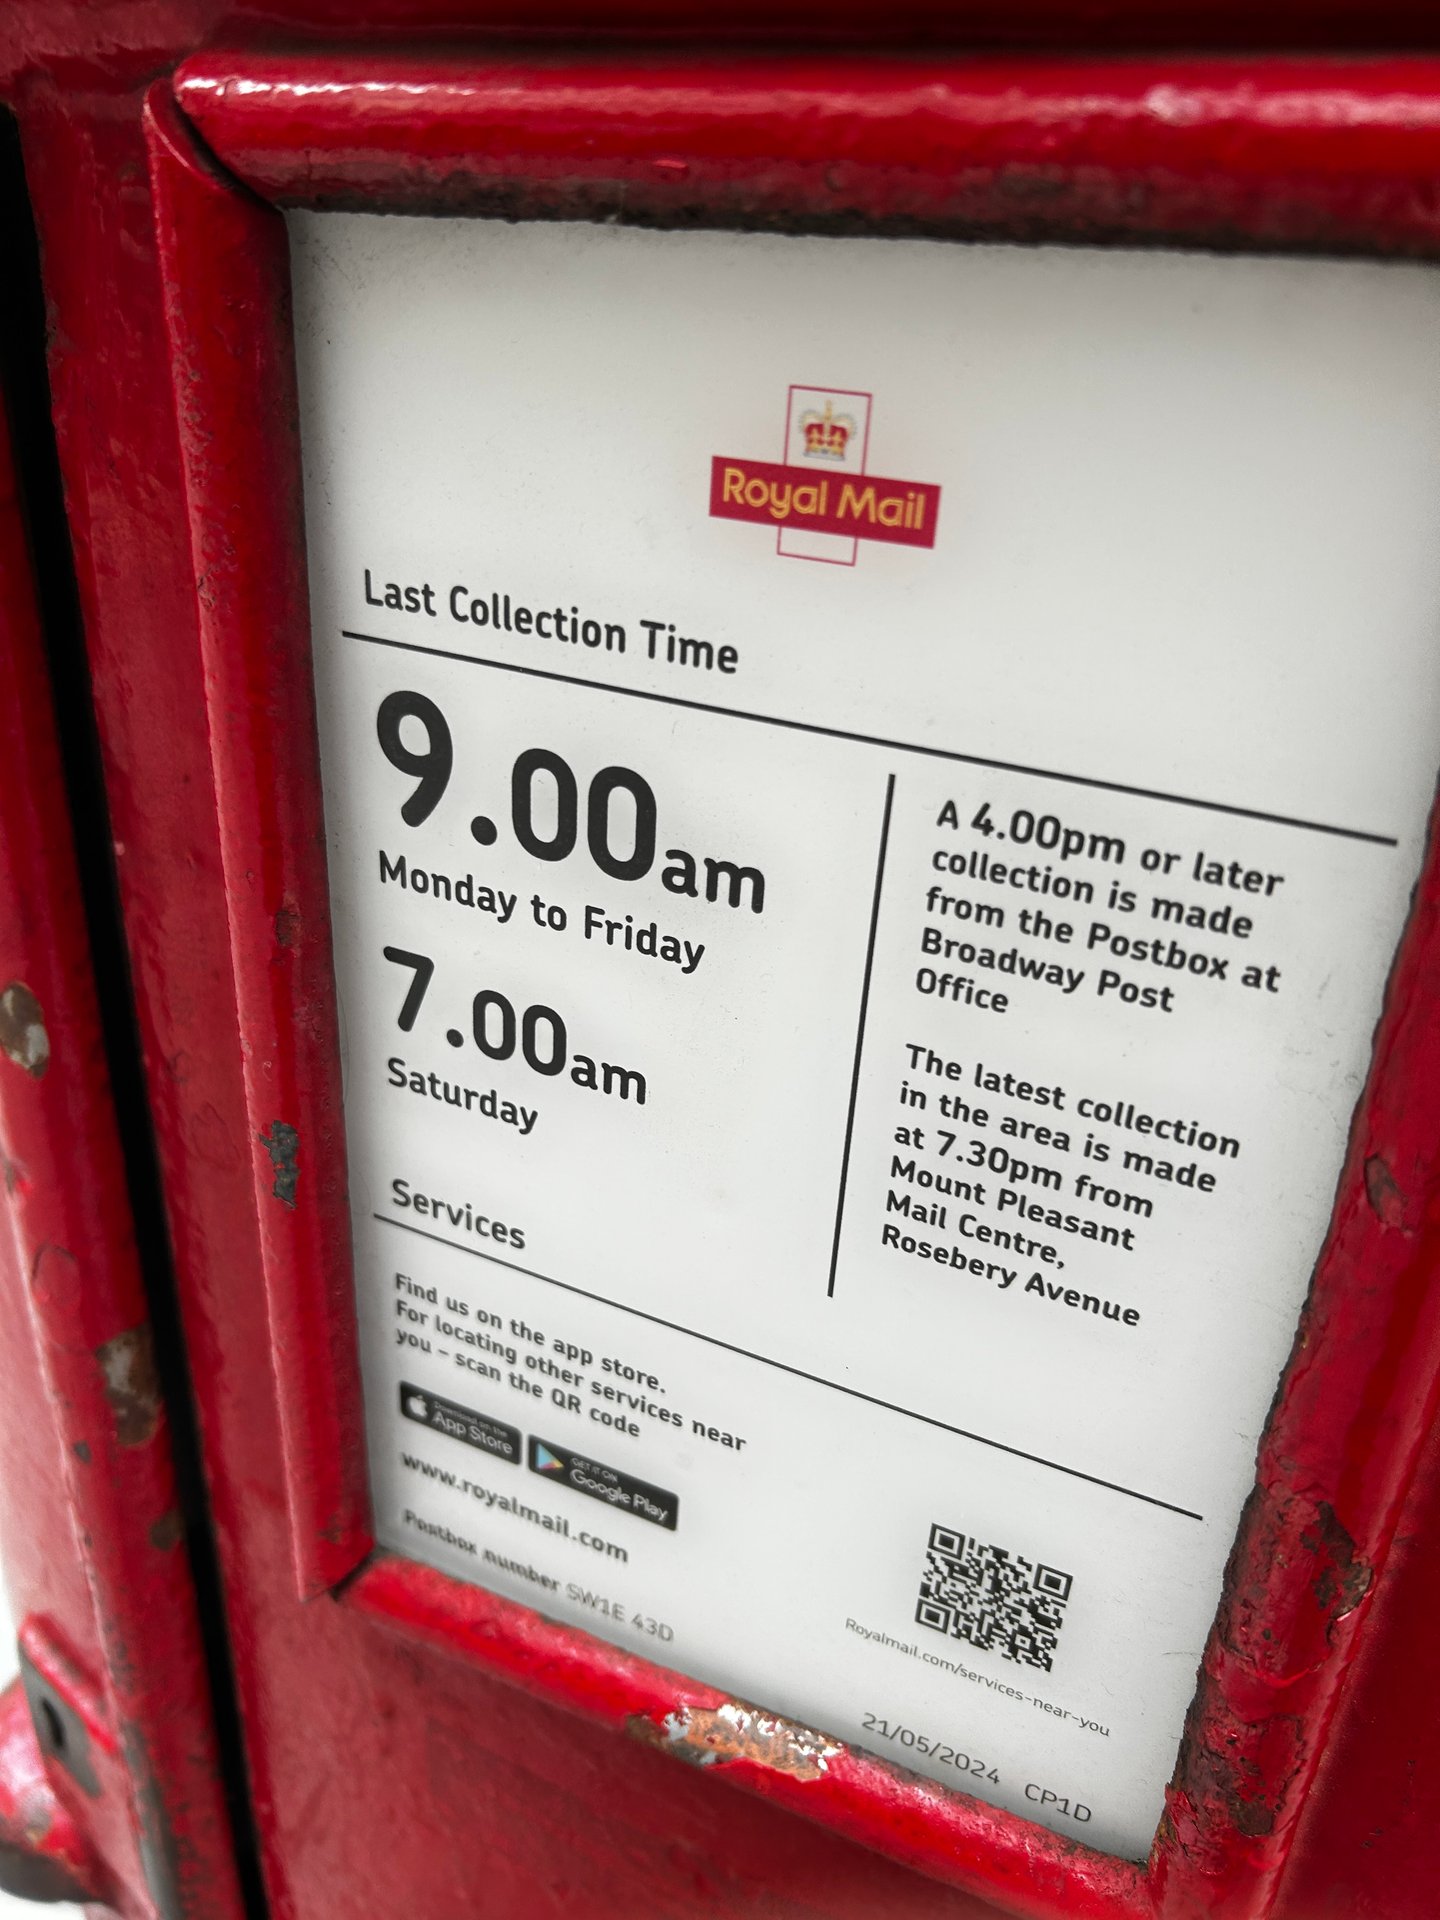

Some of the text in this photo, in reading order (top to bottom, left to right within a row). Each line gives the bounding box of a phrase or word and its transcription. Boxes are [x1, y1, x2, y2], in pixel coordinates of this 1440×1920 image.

[722, 467, 925, 530] Royal Mail
[364, 569, 738, 674] Last Collection Time
[376, 690, 765, 914] 9.00am
[936, 799, 1285, 896] A 4.00pm or later
[378, 849, 705, 974] Monday to Friday
[926, 886, 1281, 993] from the Postbox at
[932, 850, 1253, 939] collection is made
[916, 968, 1009, 1013] Office
[921, 927, 1175, 1013] Broadway Post
[383, 946, 646, 1105] 7.00am
[386, 1057, 538, 1135] Saturday
[900, 1080, 1216, 1193] in the area is made
[905, 1043, 1240, 1159] The latest collection
[390, 1178, 525, 1250] Services
[891, 1155, 1135, 1251] Mount Pleasant
[894, 1127, 1153, 1218] at 7.30pm from
[882, 1224, 1140, 1326] Rosebery Avenue
[886, 1189, 1065, 1269] Mail Centre,
[394, 1272, 665, 1393] Find us on the app store.
[395, 1299, 746, 1451] For locating other services near
[395, 1328, 432, 1353] you
[455, 1353, 501, 1382] scan
[508, 1372, 543, 1398] the
[551, 1388, 581, 1414] QR
[589, 1408, 640, 1437] code
[432, 1411, 512, 1453] App Store
[400, 1452, 628, 1563] www.royalmail.com
[570, 1469, 667, 1520] Google Play
[404, 1509, 673, 1642] Postbox number SW1E 43D
[846, 1618, 1109, 1737] Royalmail.com/services-near-you
[861, 1711, 1092, 1824] 21/05/2024 CP1D
